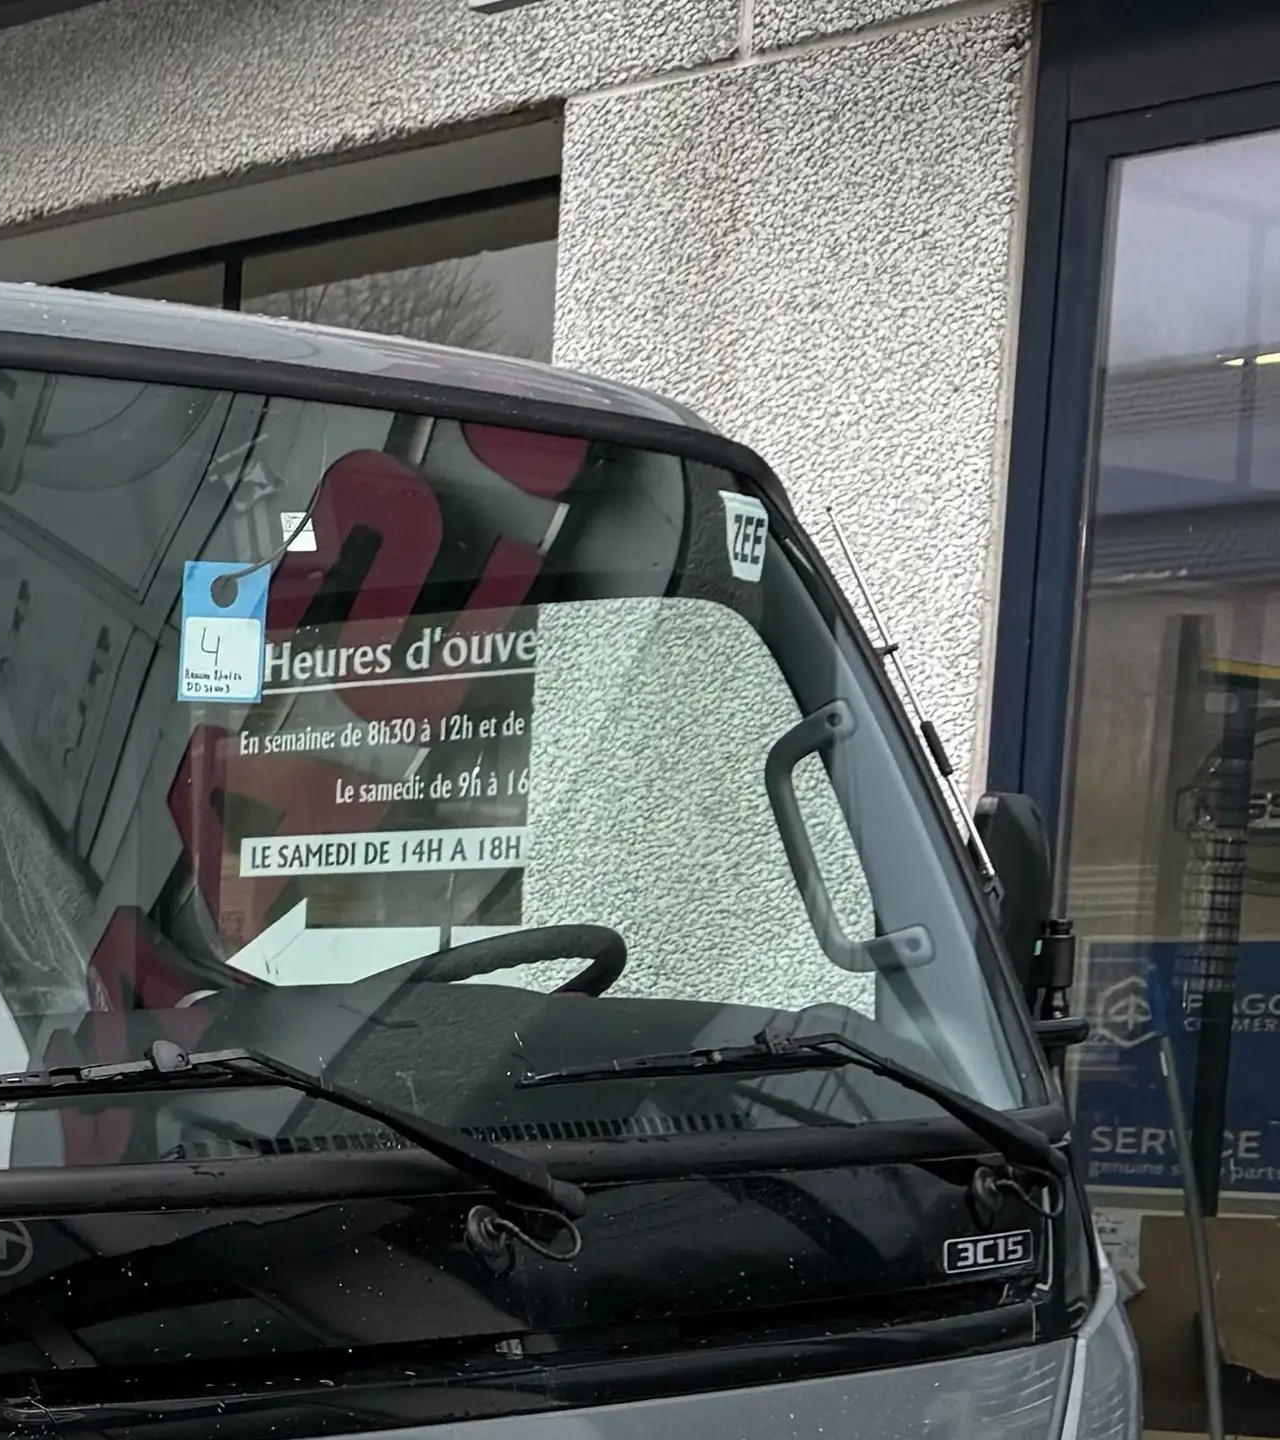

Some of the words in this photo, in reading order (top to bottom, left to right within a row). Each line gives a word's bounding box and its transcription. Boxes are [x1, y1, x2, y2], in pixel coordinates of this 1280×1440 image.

[200, 626, 221, 667] 4
[263, 639, 392, 683] Heures
[239, 730, 260, 757] En
[263, 726, 336, 753] semaine:
[340, 721, 363, 748] de
[367, 717, 416, 747] 8h30
[420, 716, 432, 743] à
[439, 713, 473, 742] 12h
[478, 715, 497, 740] et
[502, 710, 526, 738] de
[335, 778, 354, 804] Le
[358, 772, 425, 803] samedi:
[429, 777, 452, 799] de
[457, 767, 481, 799] 9h
[487, 771, 498, 796] à
[250, 845, 272, 870] LE
[276, 841, 357, 868] SAMEDI
[363, 840, 391, 866] DE
[401, 837, 443, 864] 14H
[449, 836, 468, 862] A
[477, 834, 522, 861] 18H
[956, 1235, 1024, 1267] 3C15
